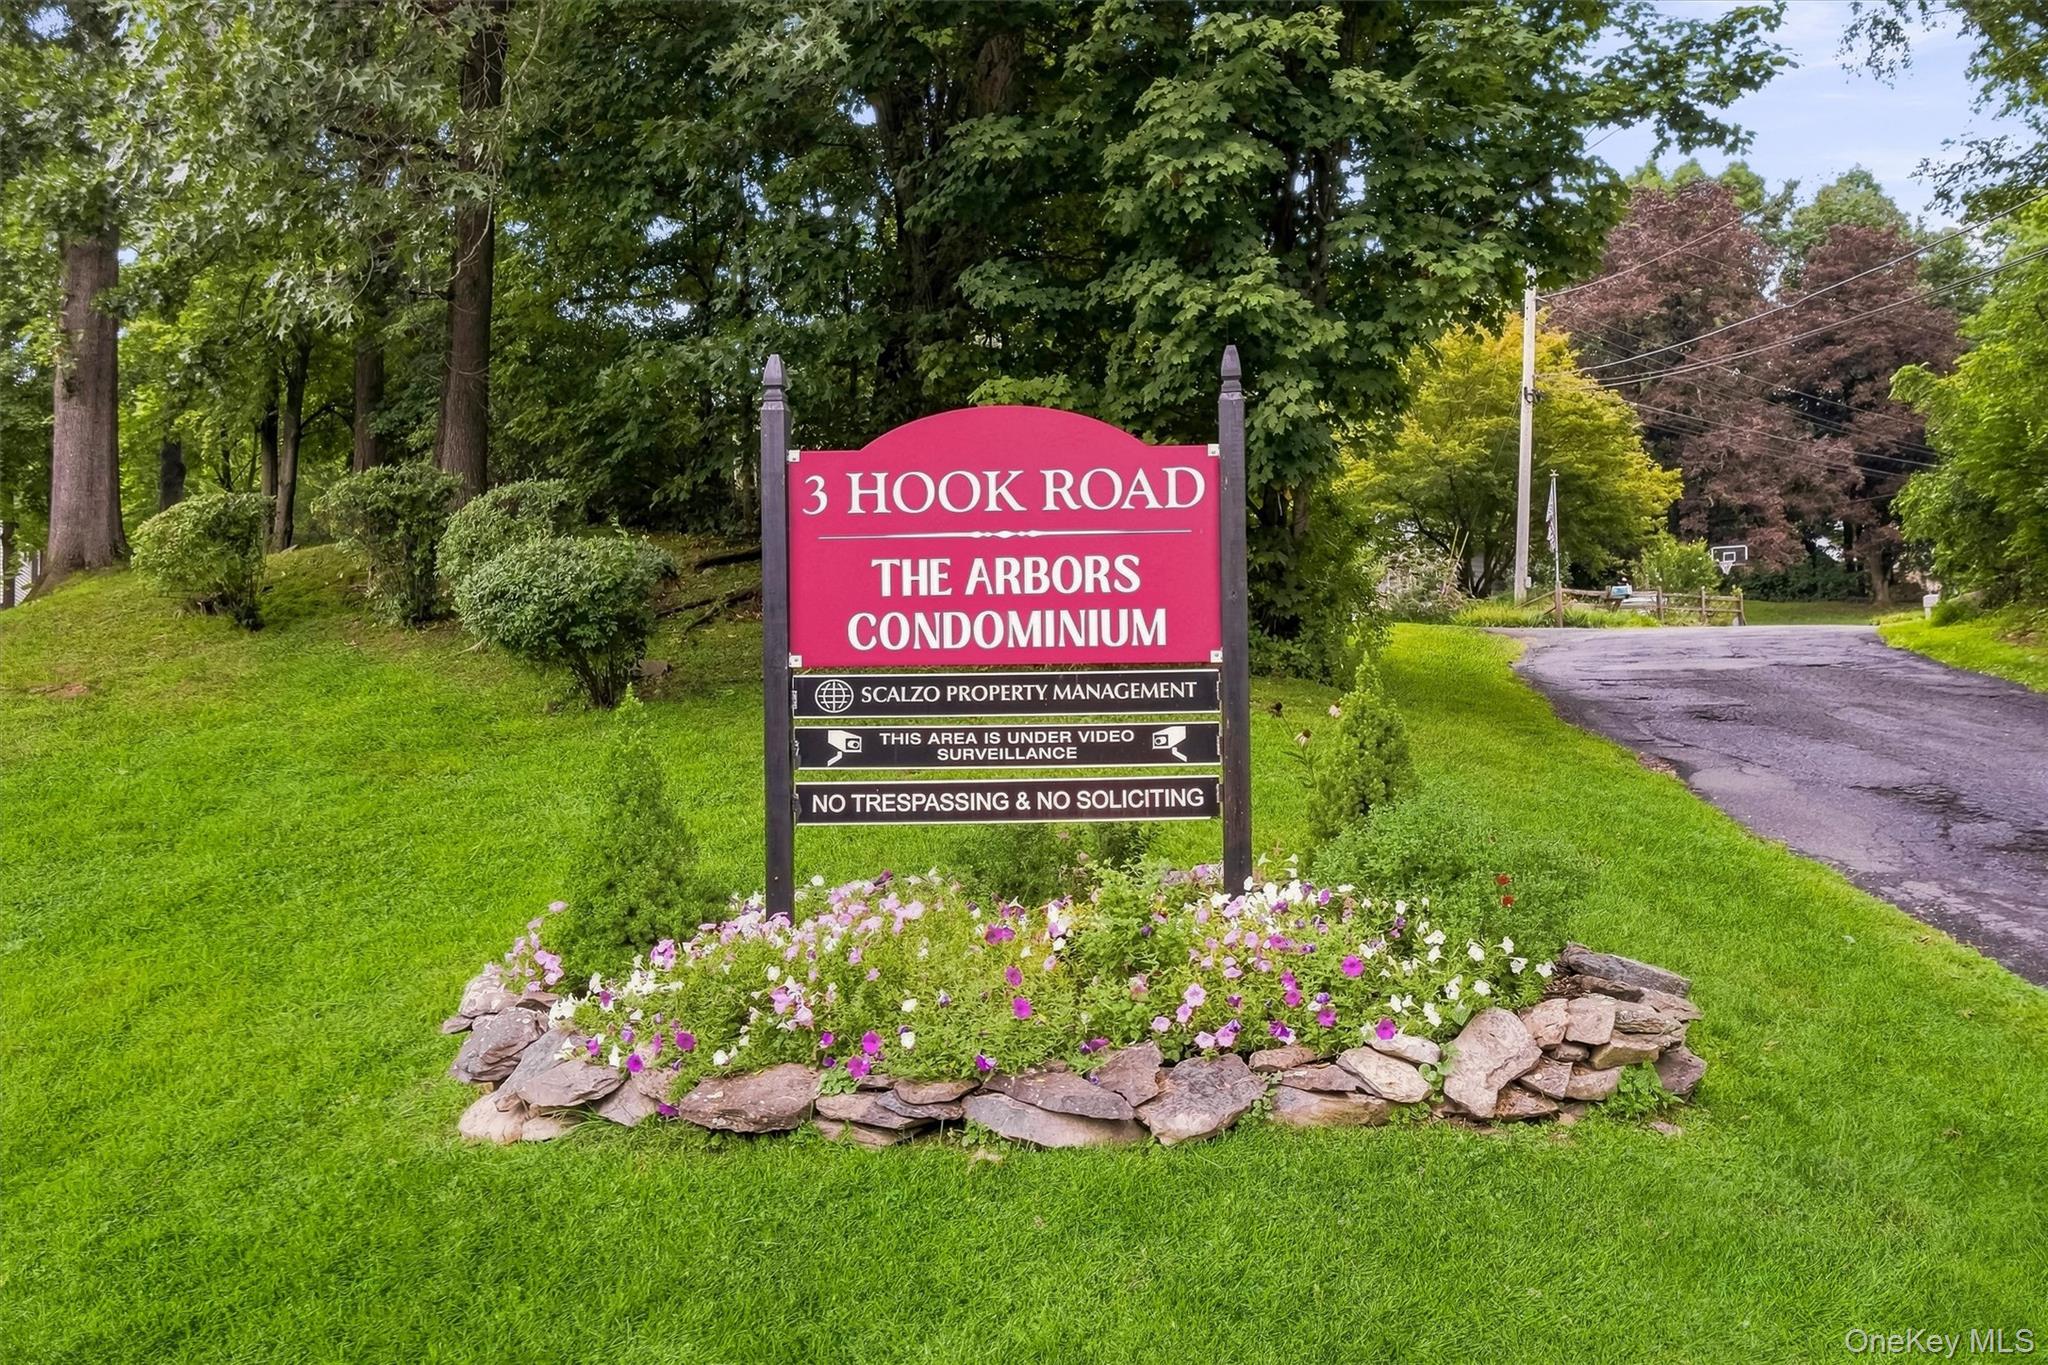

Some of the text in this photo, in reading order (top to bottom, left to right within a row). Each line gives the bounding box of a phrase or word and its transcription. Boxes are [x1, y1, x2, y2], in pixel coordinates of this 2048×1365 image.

[802, 466, 1206, 516] 3 HOOK ROAD
[871, 554, 1141, 597] THE ARBORS
[847, 608, 1167, 652] CONDOMINIUM
[861, 681, 1197, 704] SCALZO PROPERTY MANAGEMENT
[879, 729, 1135, 746] THIS AREA IS UNDER VIDEO
[936, 746, 1078, 761] SURVEILLANCE
[812, 788, 1205, 813] NO TRESPASSING & NO SOLICITING
